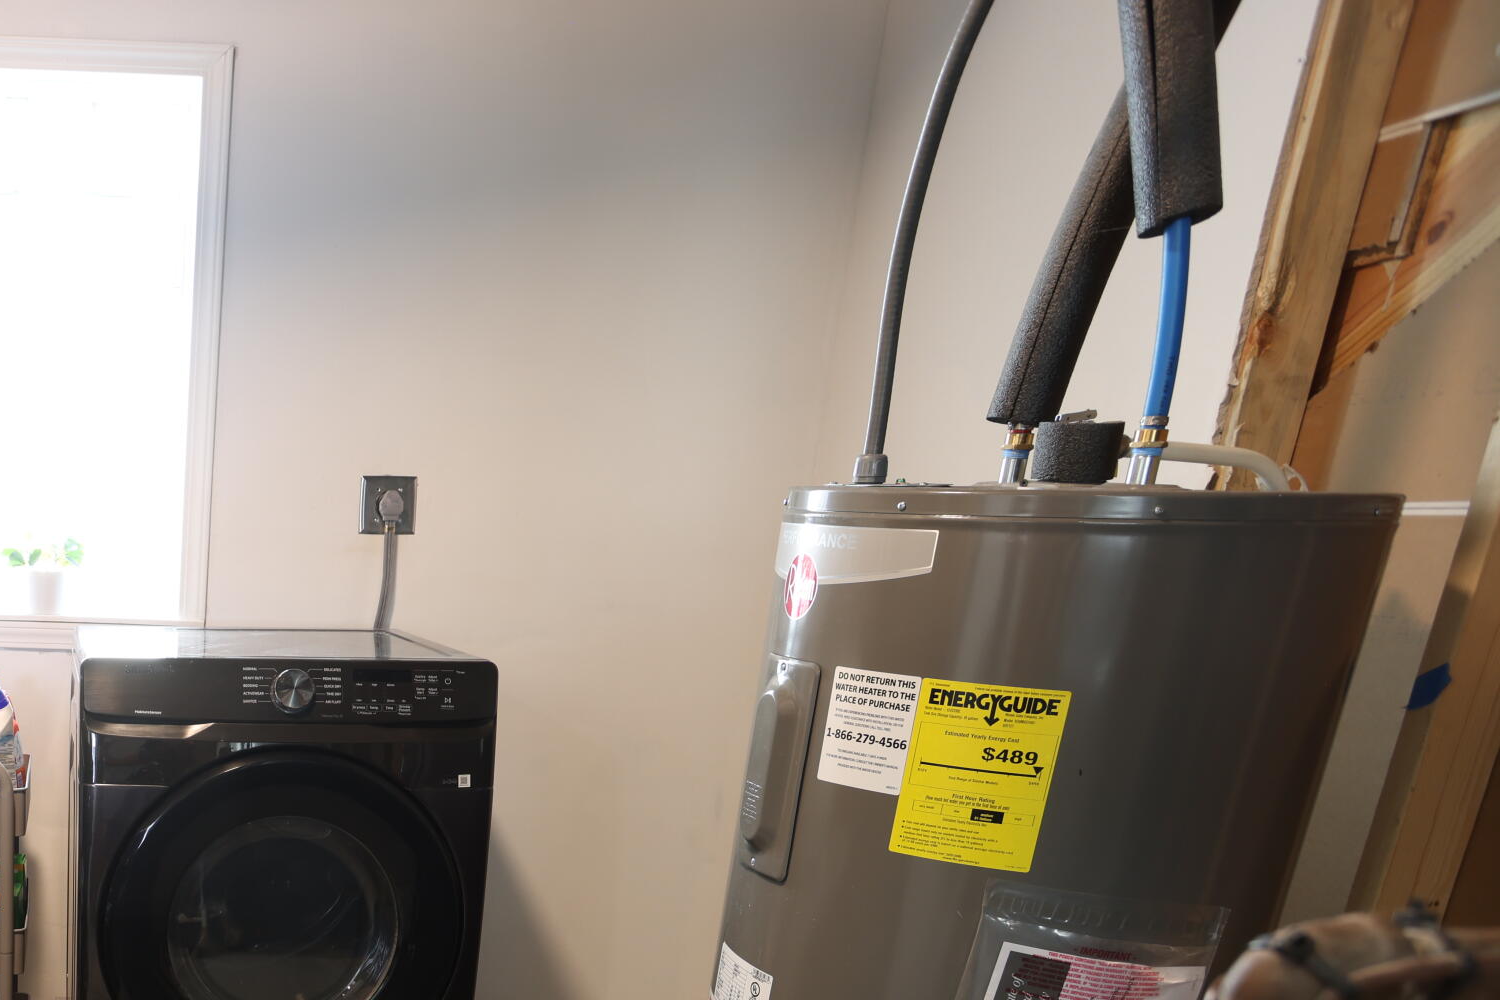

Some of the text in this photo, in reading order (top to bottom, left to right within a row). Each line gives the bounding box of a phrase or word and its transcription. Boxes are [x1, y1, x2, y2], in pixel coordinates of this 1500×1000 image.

[838, 672, 916, 689] DO NOT RETURN THIS
[836, 682, 916, 701] WATER HEATER TO THE
[836, 694, 856, 704] PLACE
[868, 700, 911, 712] PURCHASE
[928, 688, 1061, 716] ENERGYGUIDE
[827, 728, 907, 750] 1-866-279-4566
[944, 730, 969, 738] Estimated
[981, 747, 1038, 766] $489
[1012, 973, 1025, 988] of
